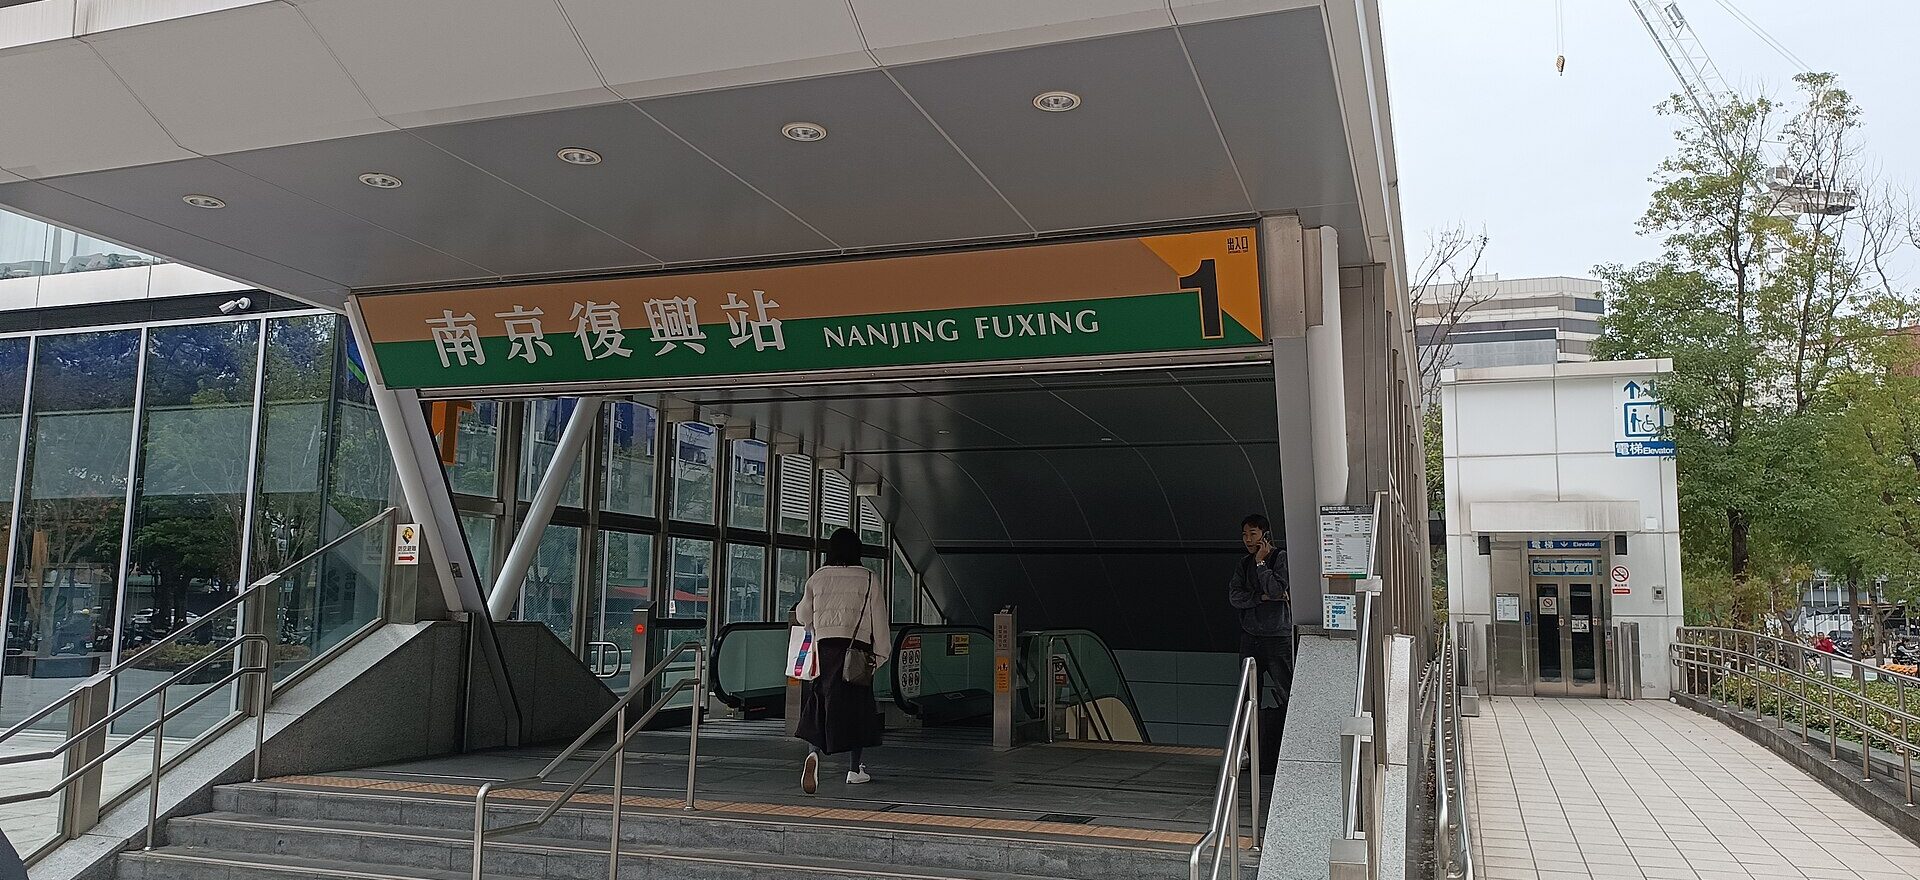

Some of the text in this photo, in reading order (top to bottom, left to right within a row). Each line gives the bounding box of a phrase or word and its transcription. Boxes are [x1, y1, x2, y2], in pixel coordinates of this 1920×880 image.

[1227, 236, 1249, 250] 出入口
[1179, 258, 1222, 338] 1
[425, 290, 786, 368] 南京復興站
[823, 310, 1099, 348] NANJING FUXING
[1616, 443, 1643, 455] 電梯
[1643, 446, 1674, 455] Elevator
